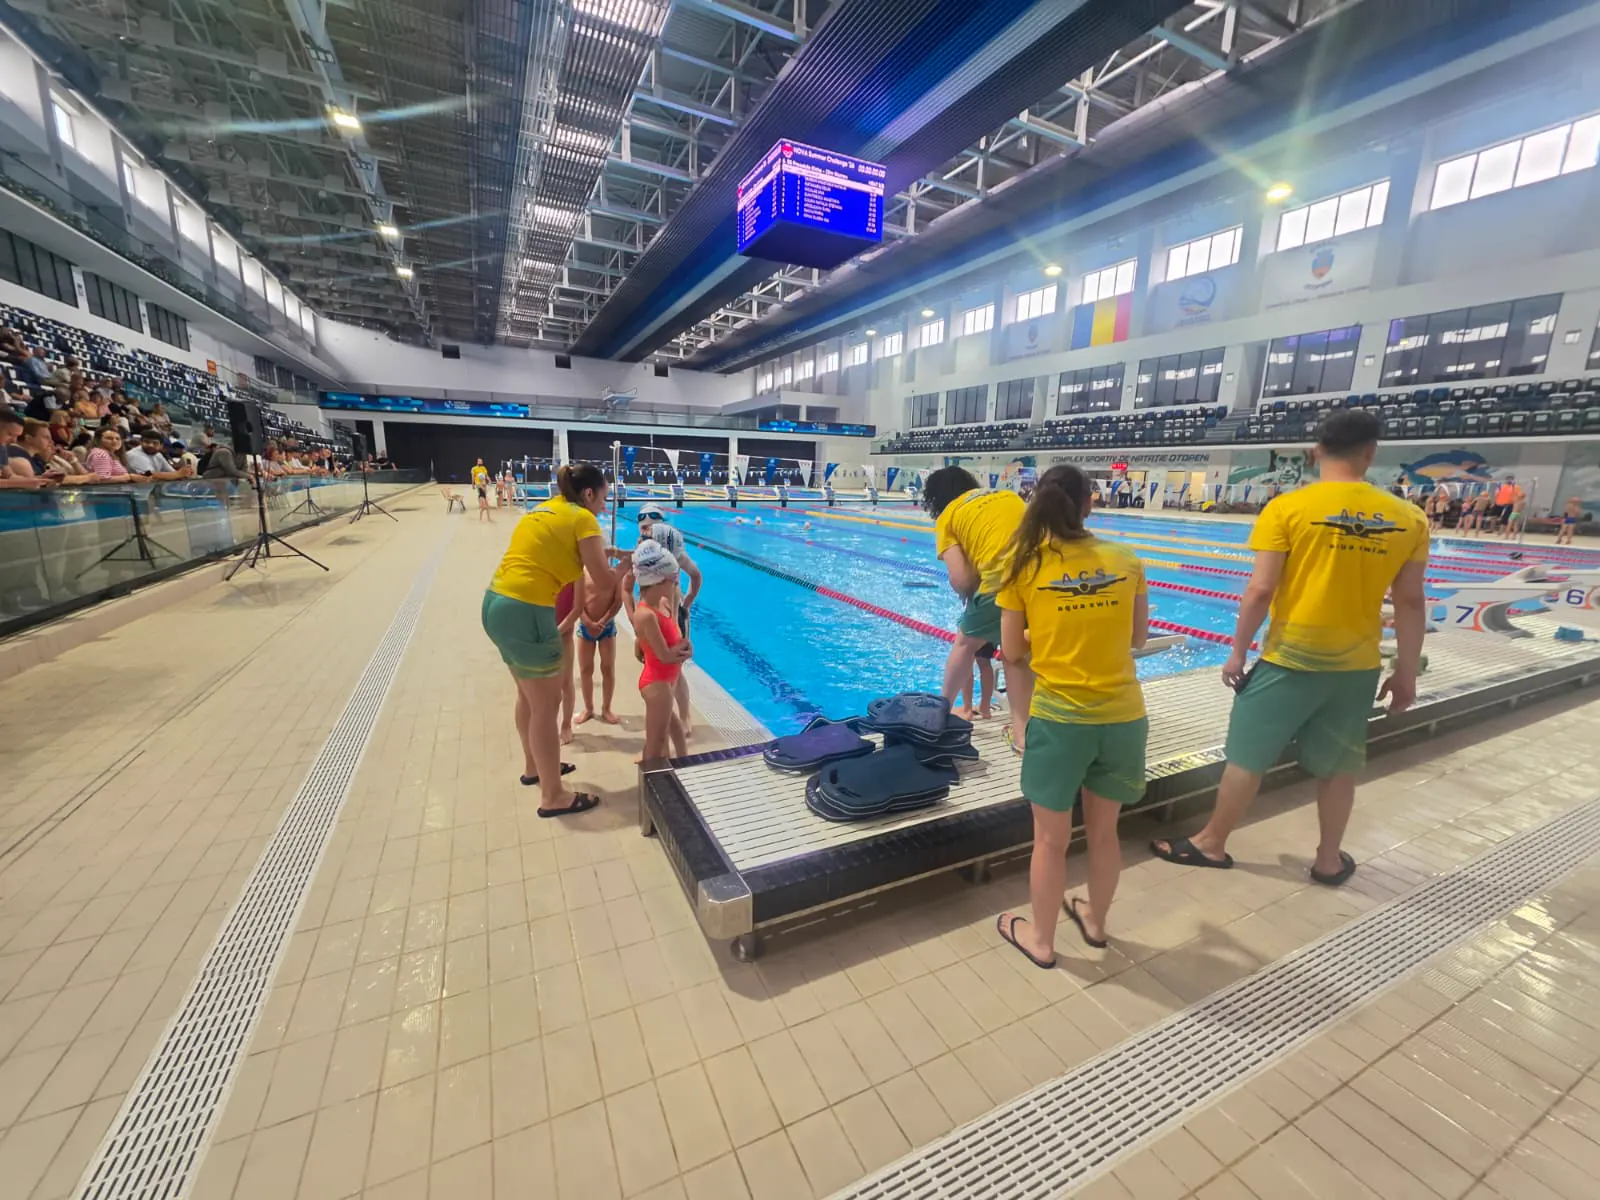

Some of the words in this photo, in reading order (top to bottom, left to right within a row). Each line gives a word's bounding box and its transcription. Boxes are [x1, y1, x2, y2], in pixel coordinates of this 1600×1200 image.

[1085, 455, 1118, 463] SPORTIV
[1118, 455, 1130, 463] DE
[1168, 453, 1210, 462] OTOPENI
[1566, 589, 1585, 605] 6
[1057, 603, 1086, 612] aqua
[1089, 600, 1119, 608] swim
[1455, 605, 1474, 623] 7
